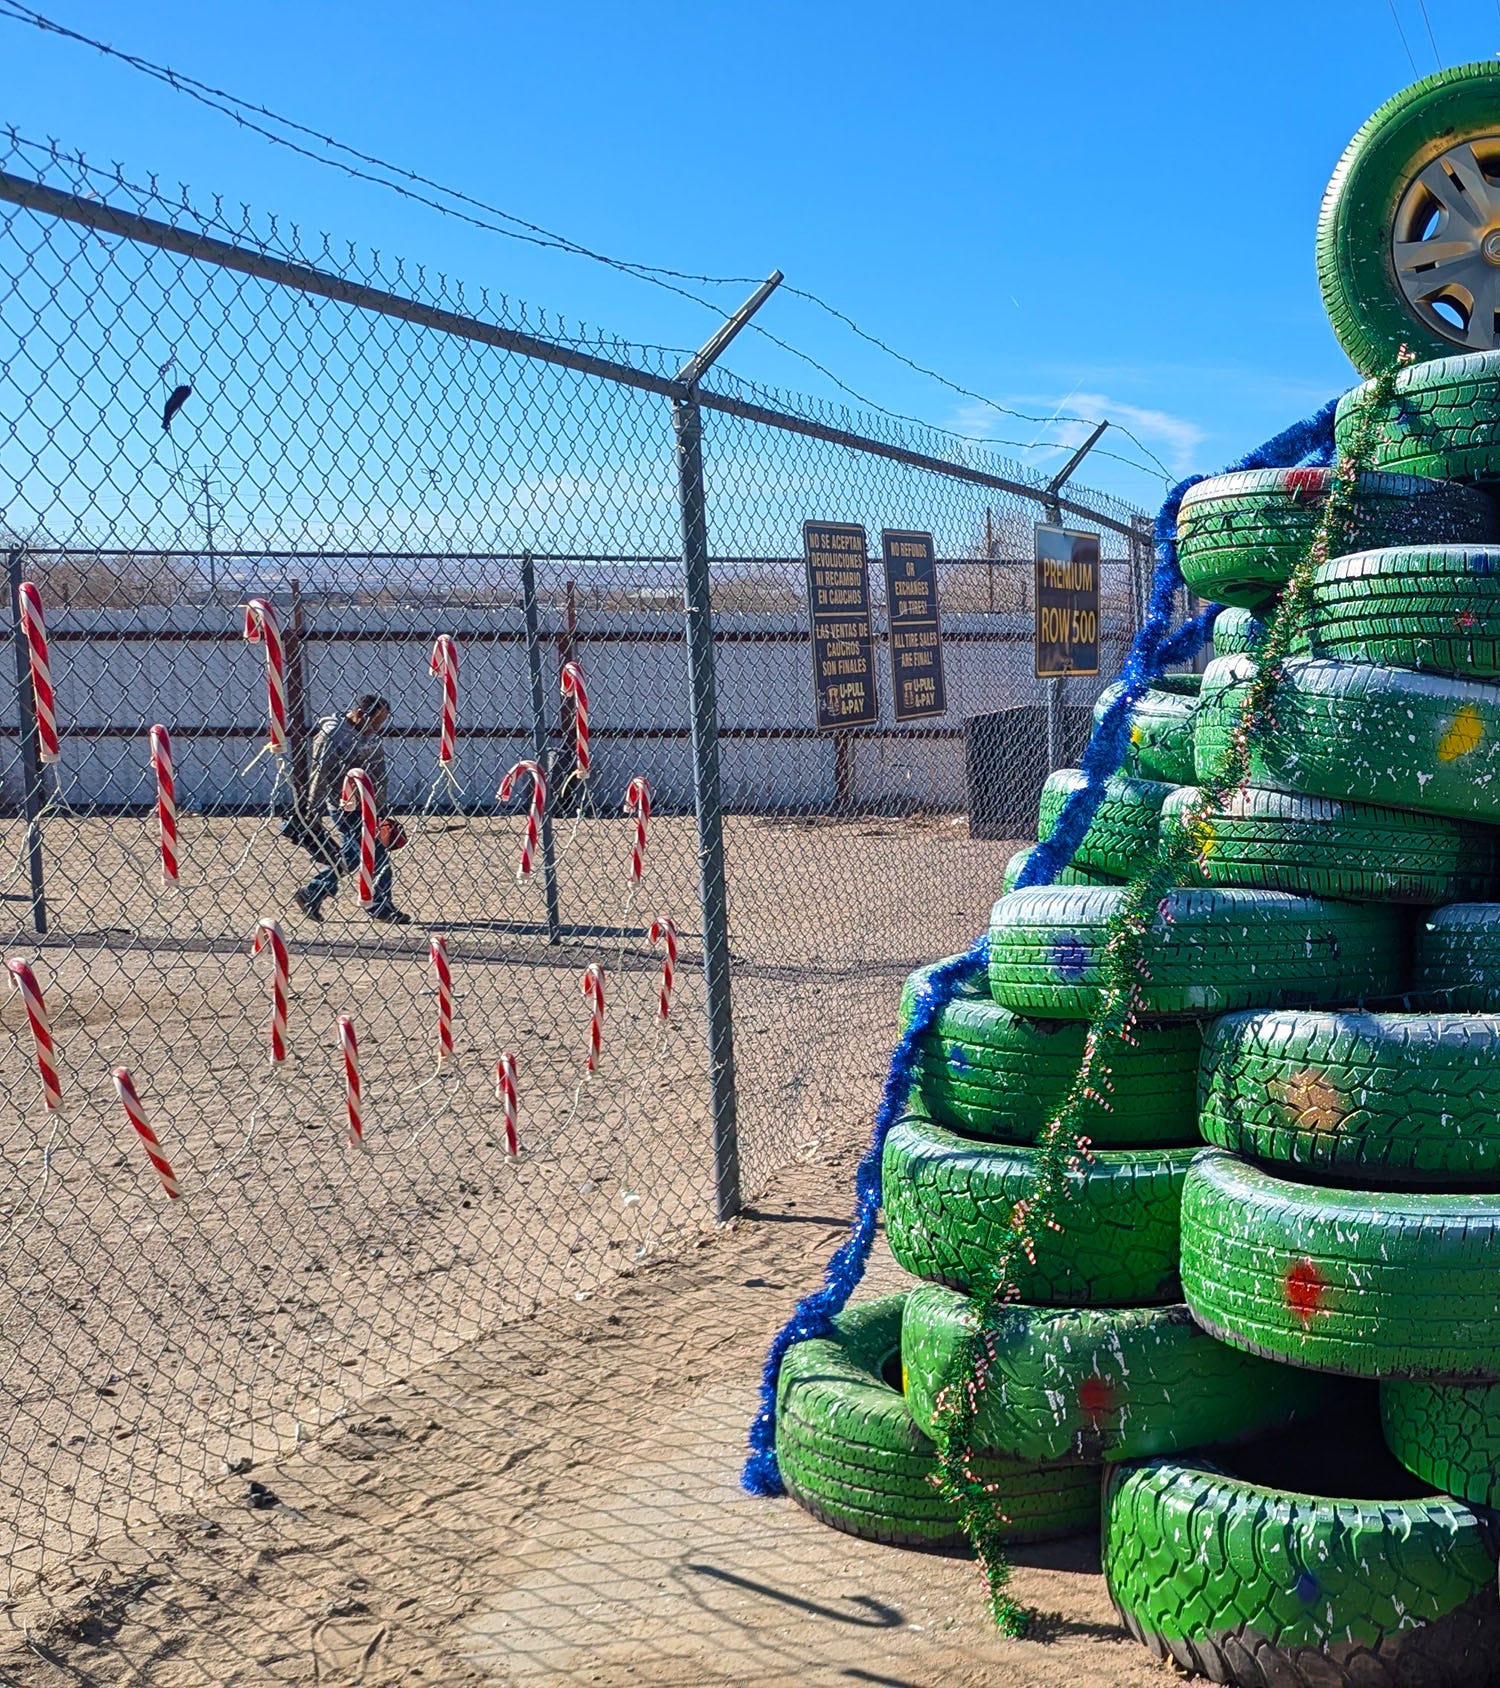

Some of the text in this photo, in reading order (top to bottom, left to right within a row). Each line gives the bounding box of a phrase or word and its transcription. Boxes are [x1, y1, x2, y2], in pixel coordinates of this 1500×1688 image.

[809, 533, 862, 550] NO SE ACEPTAN
[890, 541, 927, 558] NO REFUNDS
[811, 552, 863, 568] DEVOLUCIONES
[905, 561, 915, 576] OR
[1043, 558, 1093, 592] PREMIUM
[815, 571, 861, 586] NI RECAMBIO
[818, 589, 862, 604] EN CAUCHOS
[894, 581, 929, 596] EXCHANGES
[898, 600, 907, 615] ON
[816, 622, 868, 639] LAS VENTAS DE
[1041, 607, 1096, 644] ROW 500
[894, 632, 938, 648] ALL TIRE SALES
[826, 641, 860, 657] CAUCHOS
[822, 658, 867, 676] SON FINALES
[901, 651, 933, 668] ARE FINAL!
